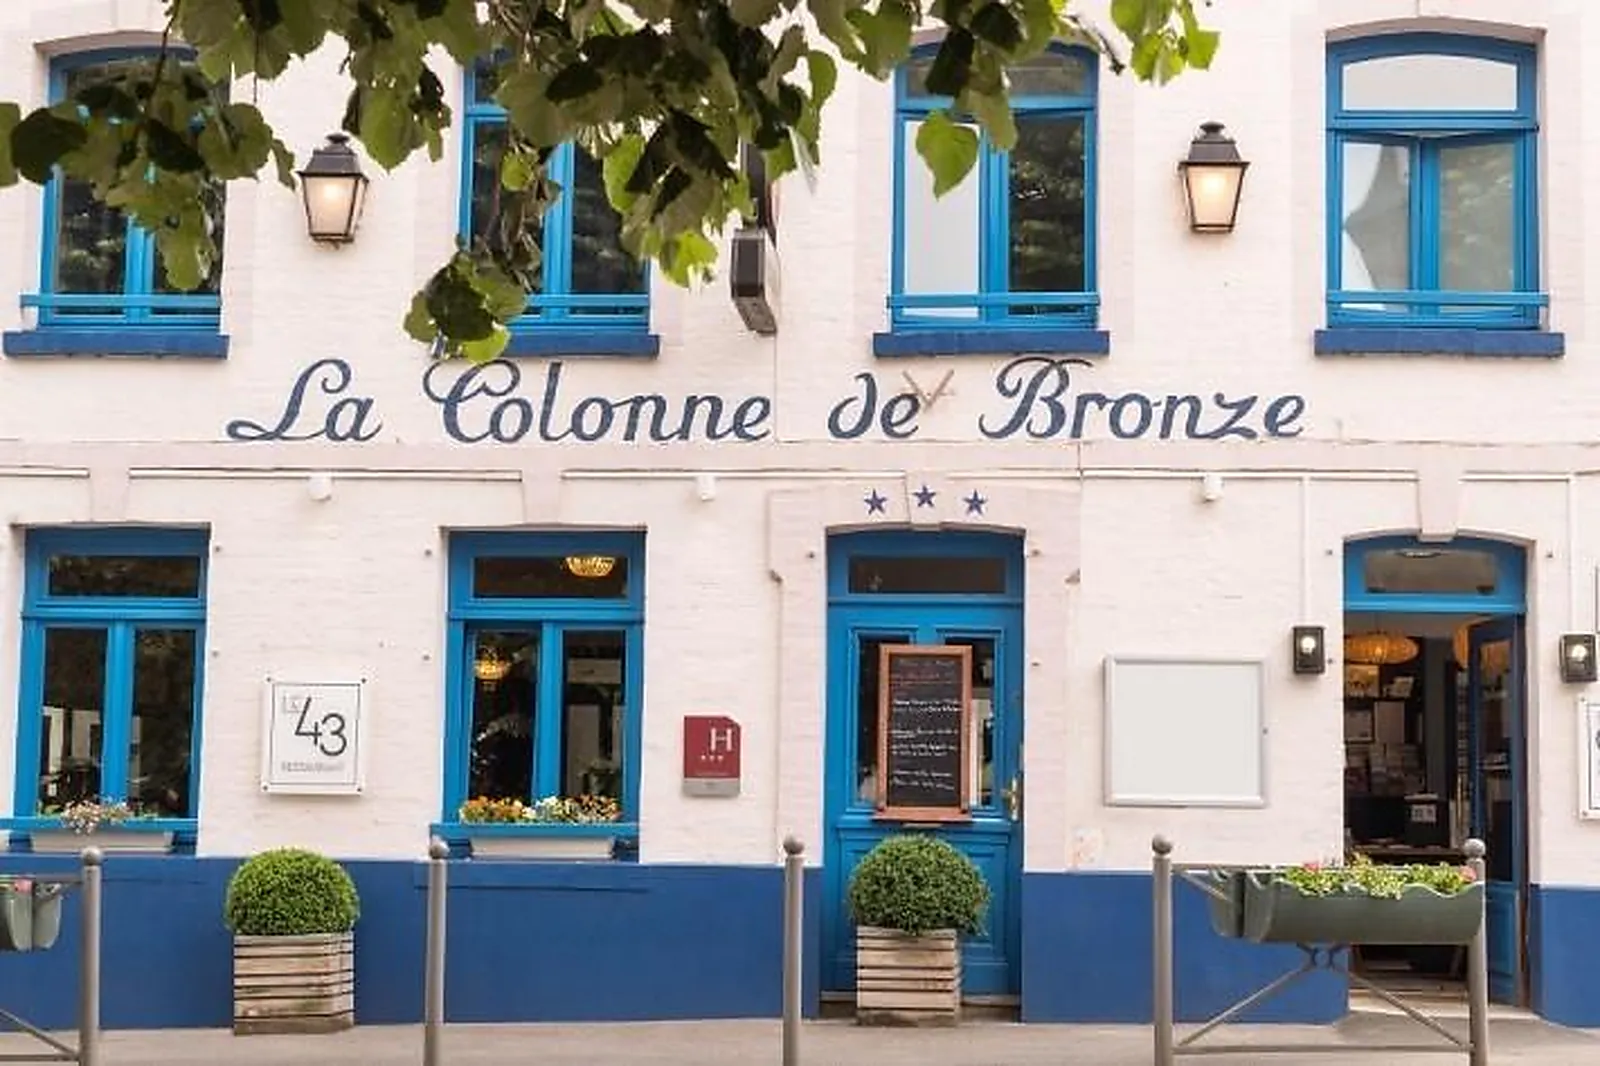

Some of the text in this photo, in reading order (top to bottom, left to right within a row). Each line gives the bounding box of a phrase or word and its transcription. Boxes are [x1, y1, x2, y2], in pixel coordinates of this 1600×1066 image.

[227, 356, 1306, 442] La Colonne de Bronze
[294, 696, 347, 756] 43
[710, 727, 732, 752] H
